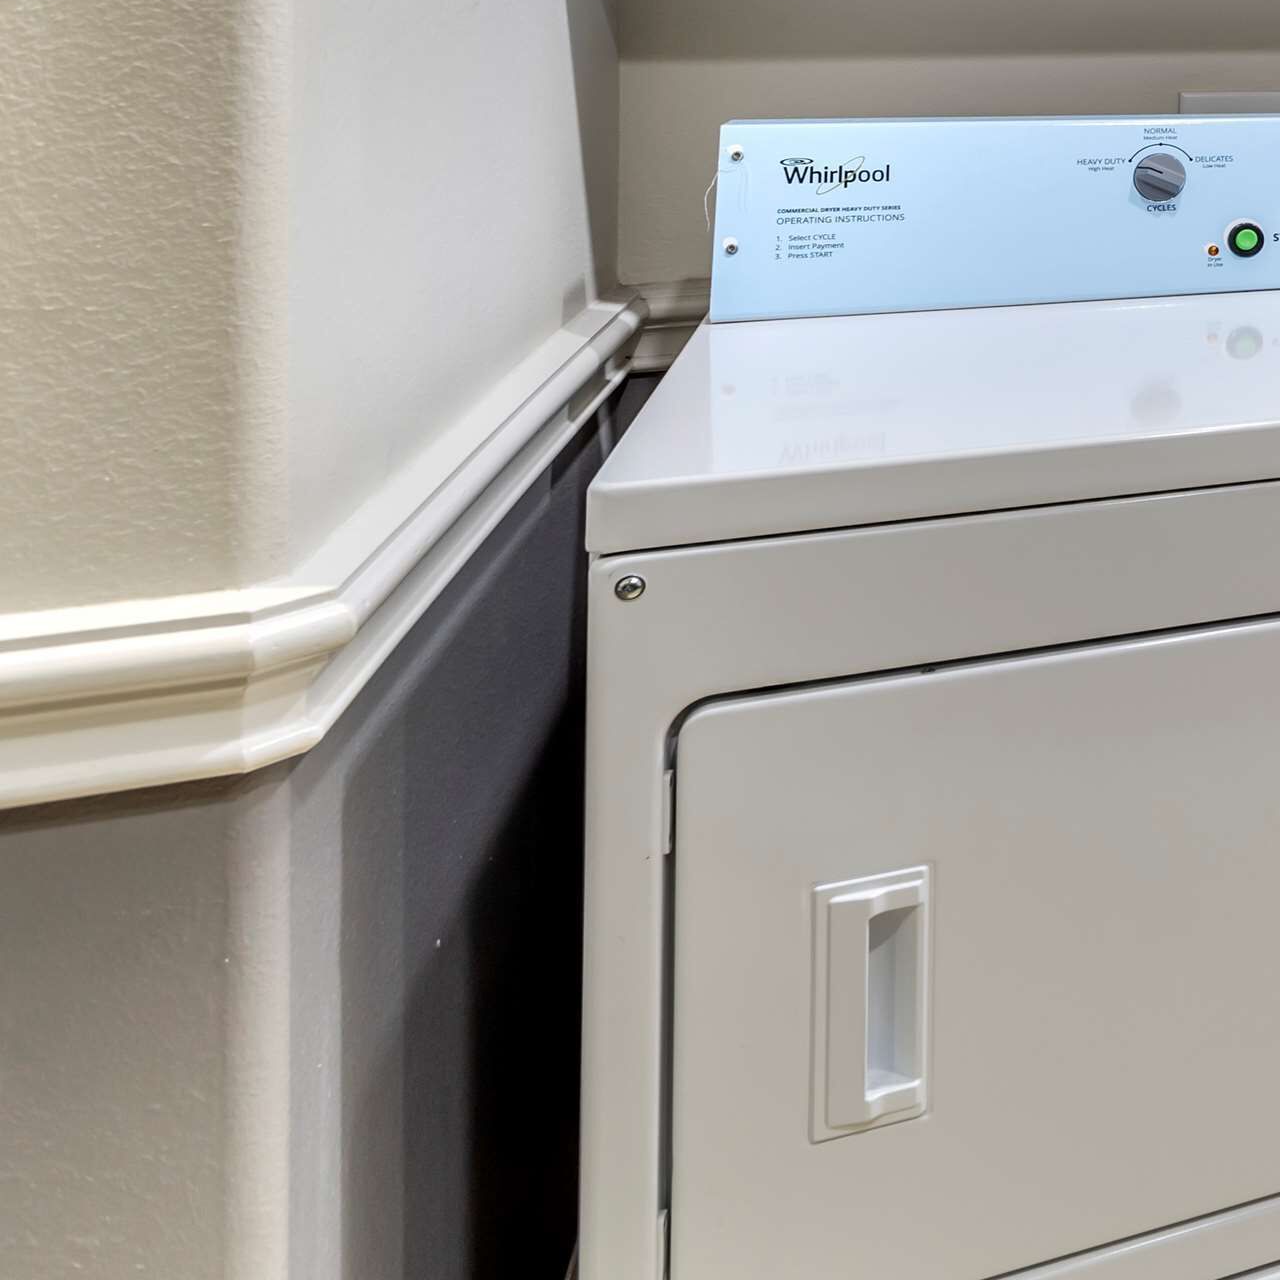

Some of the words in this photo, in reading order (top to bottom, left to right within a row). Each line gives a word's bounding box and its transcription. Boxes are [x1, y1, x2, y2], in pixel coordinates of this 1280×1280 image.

[1143, 127, 1178, 135] NORMAL
[1076, 158, 1103, 166] HEAVY
[1104, 157, 1127, 165] DUTY
[1195, 155, 1234, 163] DELICATES
[783, 164, 890, 189] Whirlpool
[1146, 204, 1177, 213] CYCLES
[776, 216, 833, 225] OPERATING
[835, 213, 905, 223] INSTRUCTIONS
[788, 234, 811, 242] Select
[812, 242, 845, 251] Payment
